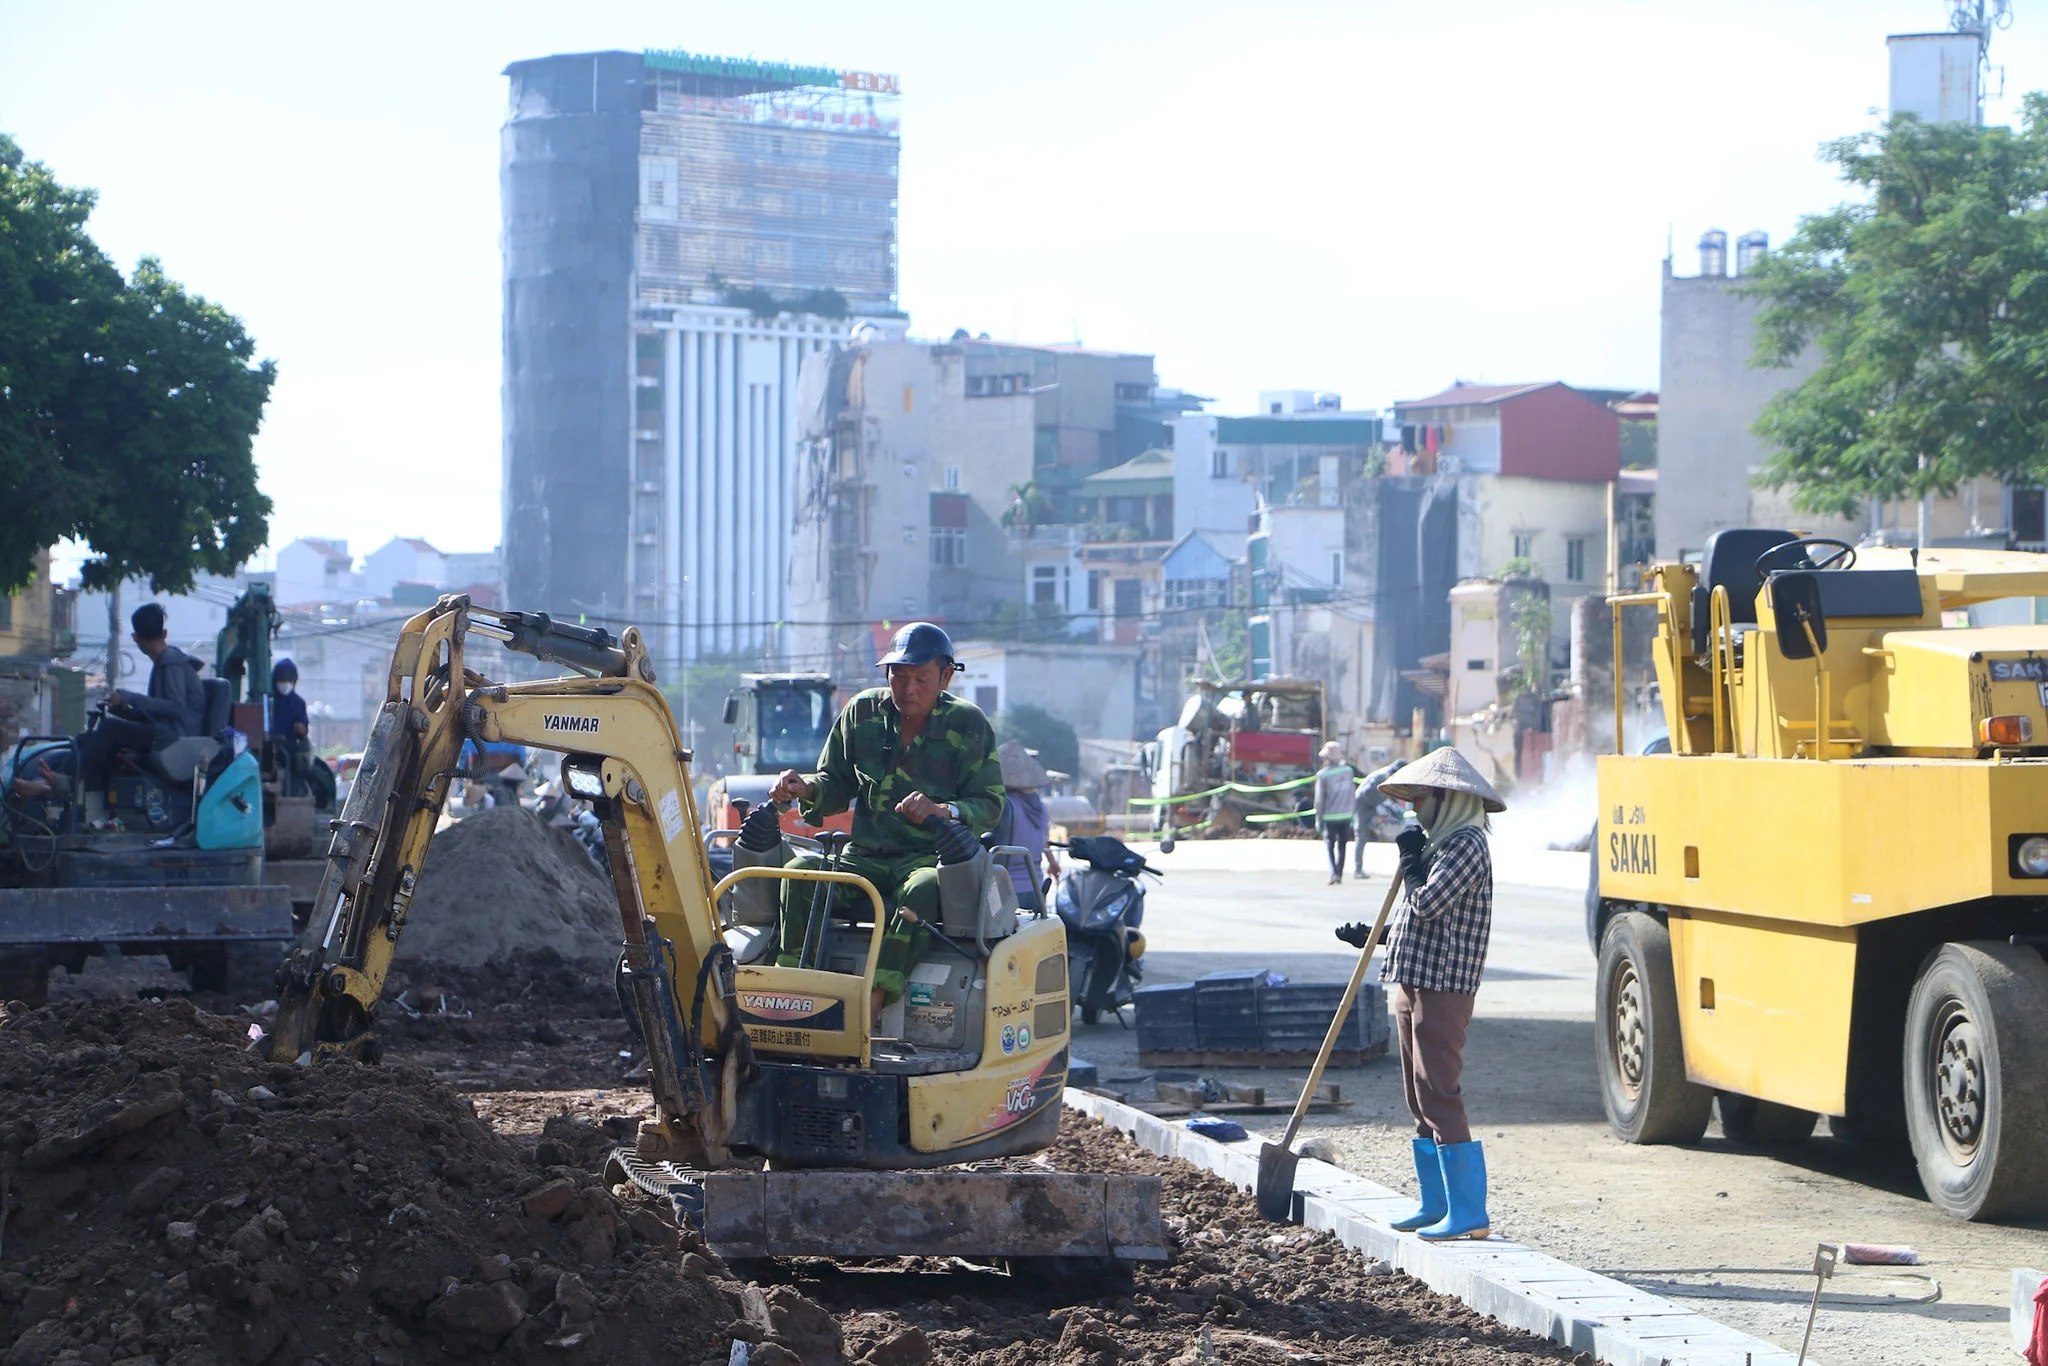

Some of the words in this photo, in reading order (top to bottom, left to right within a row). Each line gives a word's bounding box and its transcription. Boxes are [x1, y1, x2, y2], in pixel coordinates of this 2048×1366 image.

[543, 713, 600, 734] YANMAR
[1610, 831, 1657, 875] SAKAI
[743, 994, 814, 1013] YANMAR
